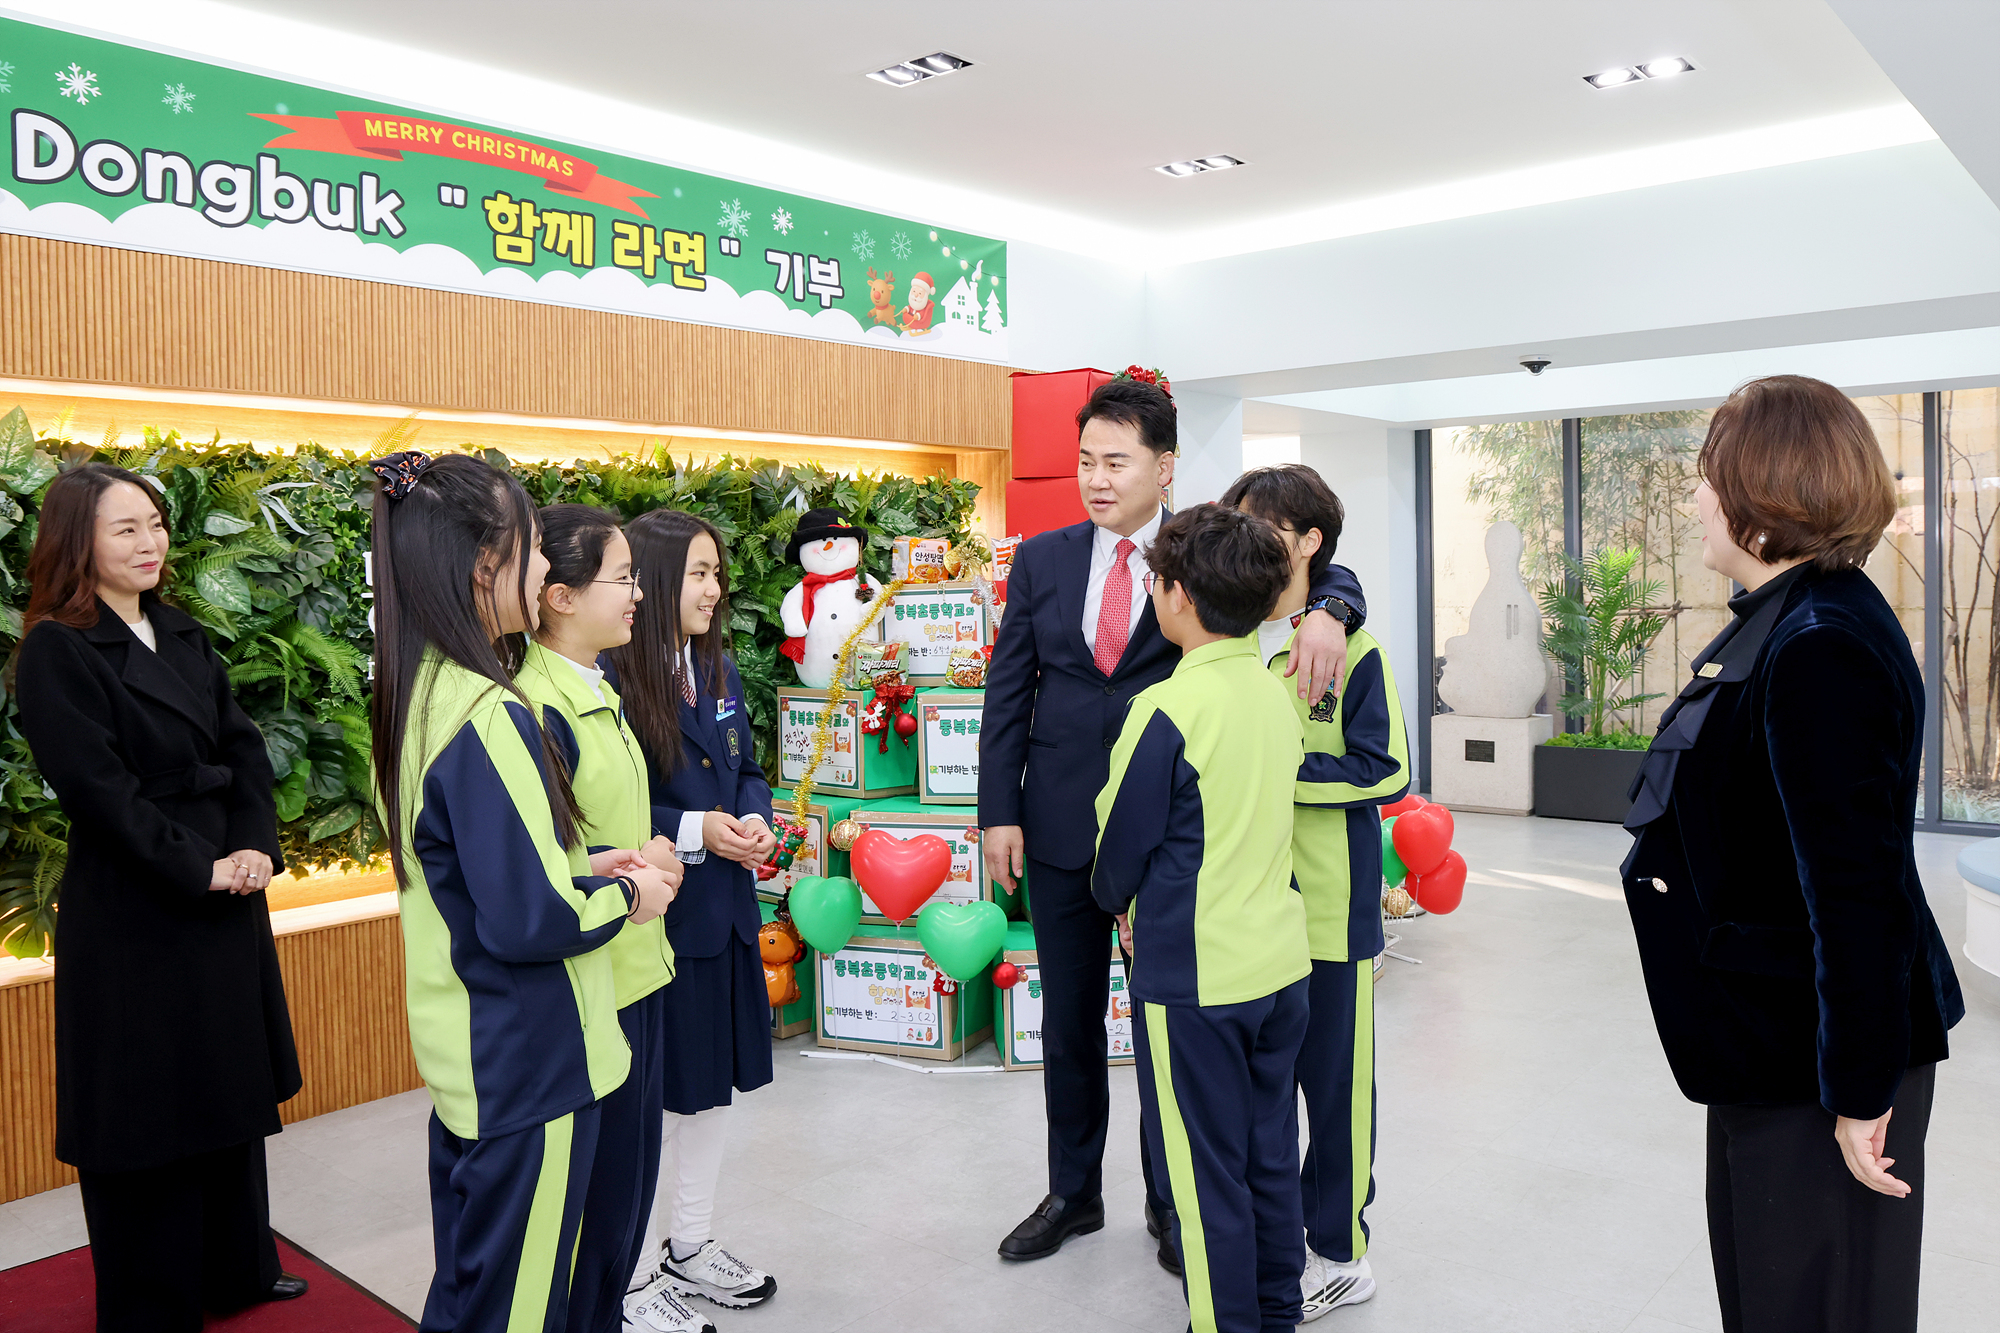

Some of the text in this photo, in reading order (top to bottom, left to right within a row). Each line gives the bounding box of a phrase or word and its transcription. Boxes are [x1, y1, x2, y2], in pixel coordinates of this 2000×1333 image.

[364, 117, 575, 177] MERRY CHRISTMAS
[11, 108, 407, 238] Dongbuk
[482, 190, 595, 269] 함께
[612, 218, 707, 291] 라면
[765, 248, 845, 309] 기부
[895, 603, 975, 621] 동북초등학교와
[860, 659, 901, 674] 짜파게티
[950, 656, 986, 669] 짜파게티
[939, 718, 981, 736] 동북초
[834, 959, 928, 981] 동북초등학교와
[834, 1006, 863, 1019] 기부하는
